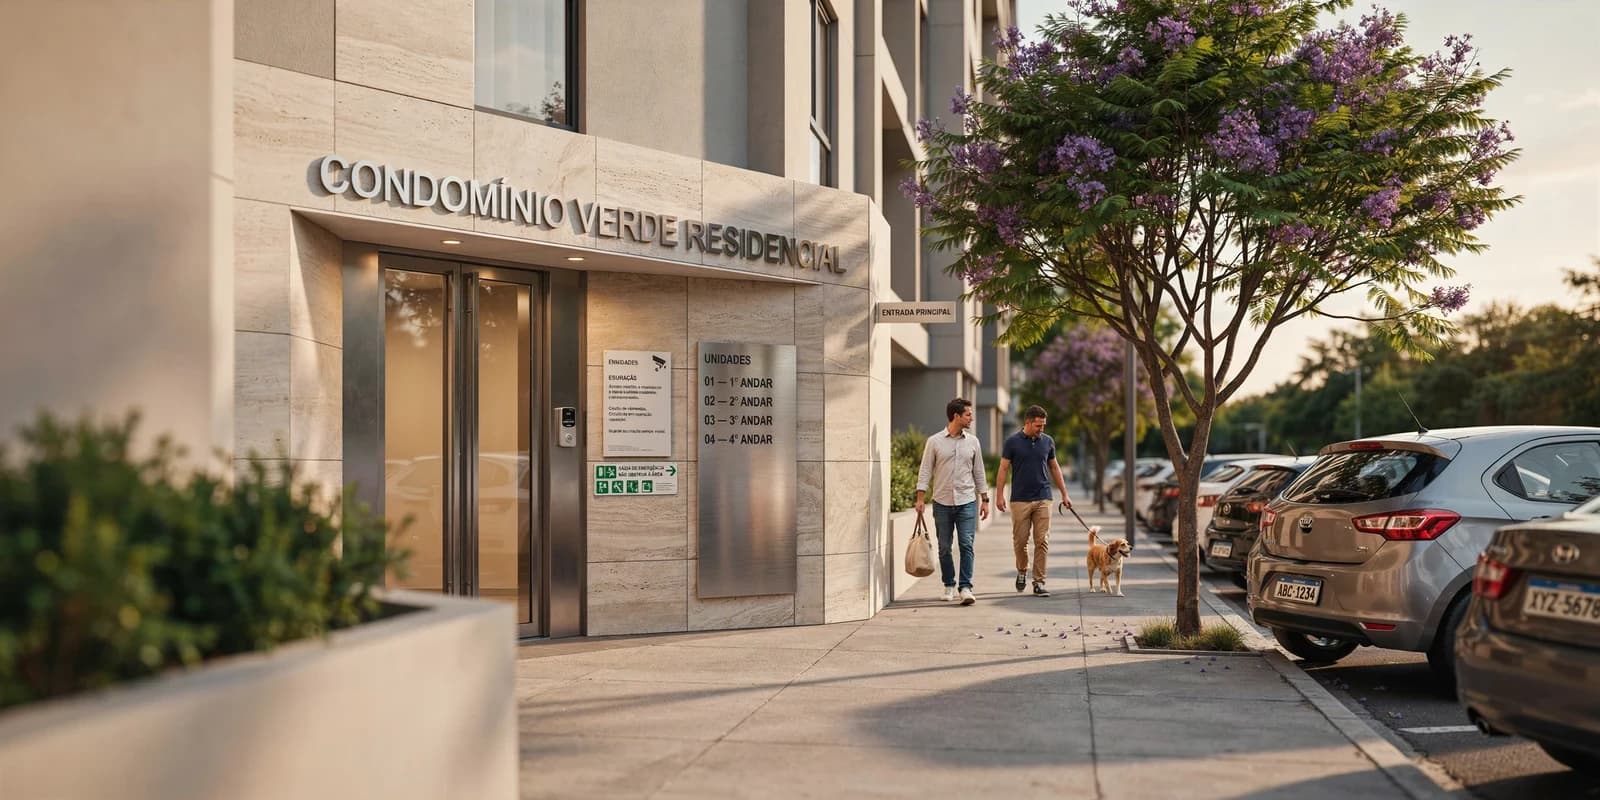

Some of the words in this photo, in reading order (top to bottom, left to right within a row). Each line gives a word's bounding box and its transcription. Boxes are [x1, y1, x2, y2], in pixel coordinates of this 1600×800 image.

[320, 154, 566, 228] CONDOMÍNIO
[573, 197, 678, 248] VERDE
[686, 219, 847, 273] RESIDENCIAL
[704, 353, 751, 365] UNIDADES
[704, 376, 715, 386] 01
[740, 378, 773, 388] ANDAR
[704, 395, 715, 406] 02
[740, 397, 773, 407] ANDAR
[704, 415, 715, 425] 03
[740, 415, 773, 426] ANDAR
[704, 434, 715, 444] 04
[740, 434, 773, 444] ANDAR
